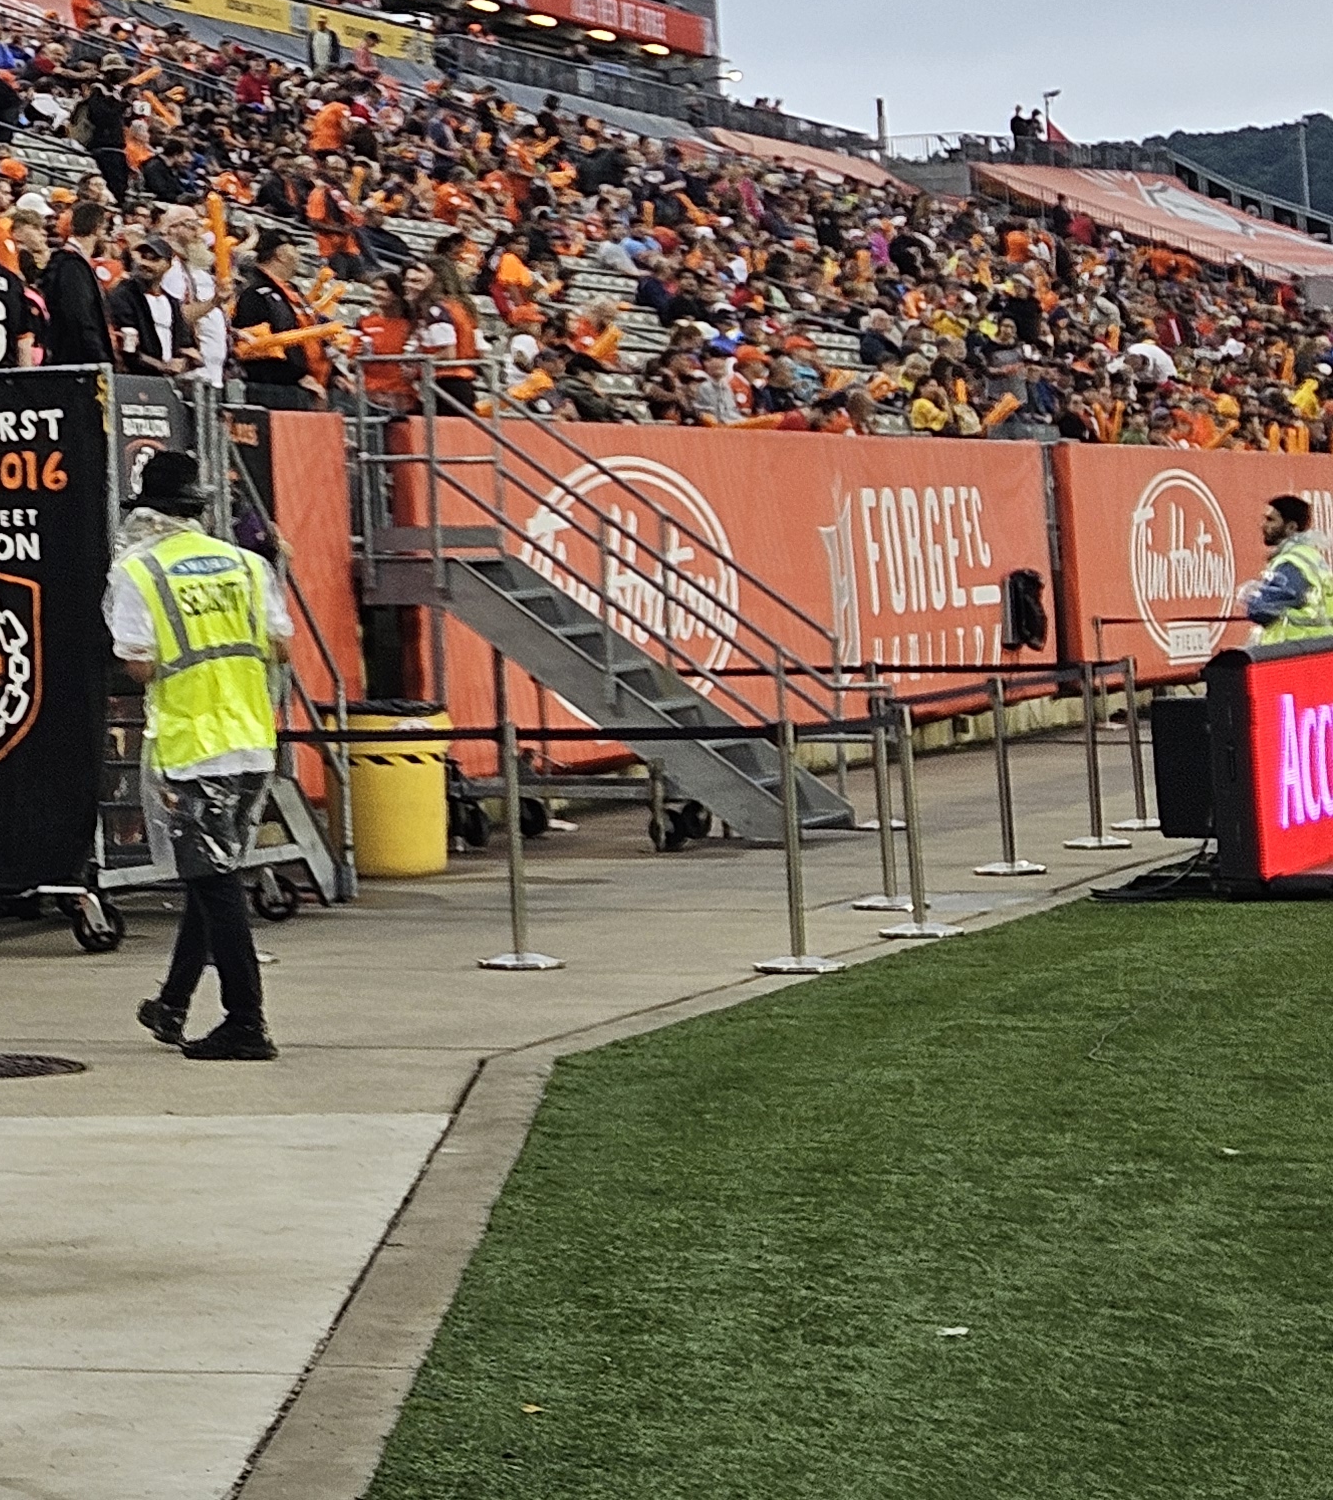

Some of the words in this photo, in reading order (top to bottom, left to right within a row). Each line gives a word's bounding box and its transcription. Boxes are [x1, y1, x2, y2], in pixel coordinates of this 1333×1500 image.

[860, 486, 967, 616] FORGE
[959, 486, 992, 569] FC
[1134, 506, 1169, 602] Tim
